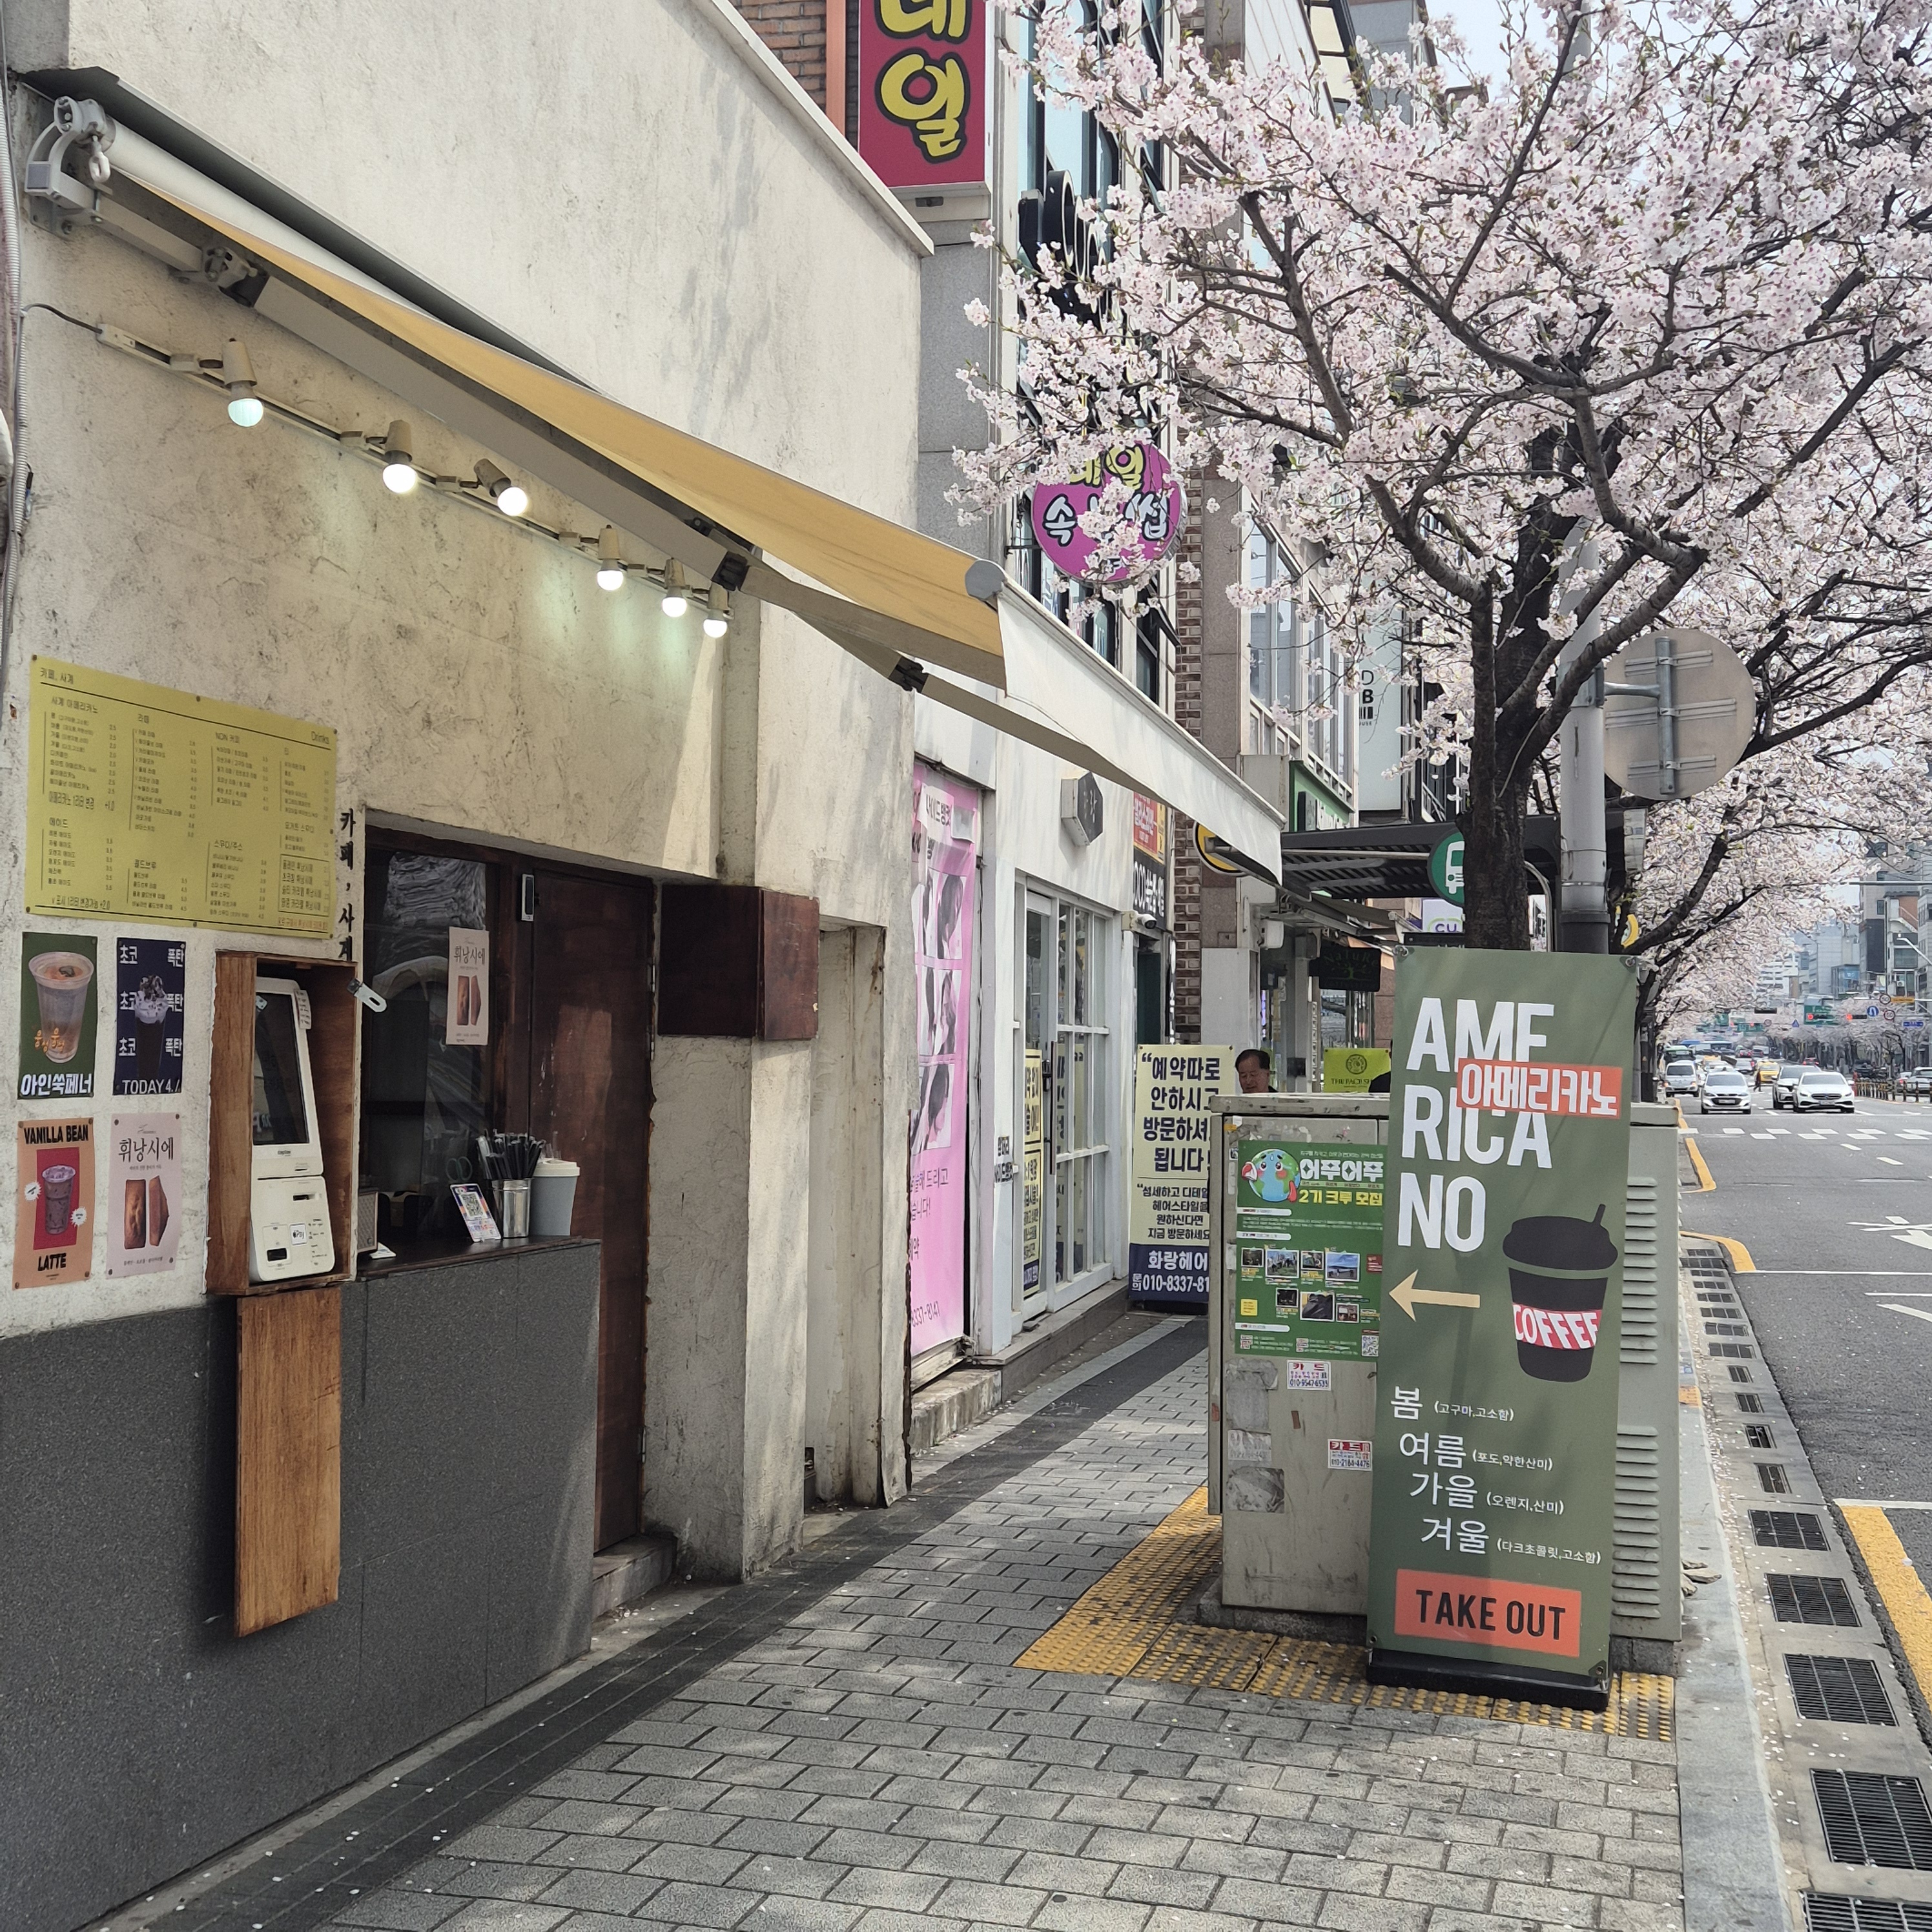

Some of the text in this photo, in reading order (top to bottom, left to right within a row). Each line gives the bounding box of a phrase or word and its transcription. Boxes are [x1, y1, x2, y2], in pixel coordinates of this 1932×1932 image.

[1044, 494, 1170, 546] 속썹
[1362, 689, 1374, 704] B
[1435, 923, 1457, 932] CU
[119, 944, 185, 968] 초코 폭탄
[453, 945, 486, 966] 휘낭시에
[118, 1037, 183, 1057] 초코 폭탄
[20, 1072, 92, 1096] 아인쑥페너
[121, 1079, 165, 1094] TODAY
[1461, 1063, 1618, 1116] 아메리카노
[24, 1124, 89, 1145] VANILLA BEAN
[1143, 1116, 1210, 1142] 방문하셔
[118, 1136, 174, 1163] 휘낭시에
[1299, 1158, 1384, 1182] 어푸어푸
[1299, 1189, 1383, 1206] 2기 크루 모집
[1156, 1214, 1204, 1226] 원하신다면
[1397, 1171, 1486, 1253] NO
[1147, 1228, 1209, 1240] 지금 방문하세요
[37, 1252, 67, 1271] LATTE
[1147, 1250, 1208, 1271] 화랑헤어
[1390, 1385, 1423, 1421] 봄
[1399, 1431, 1467, 1469] 여름
[1410, 1472, 1478, 1510] 가을
[1421, 1516, 1490, 1555] 겨울
[1416, 1588, 1567, 1641] TAKE OUT
